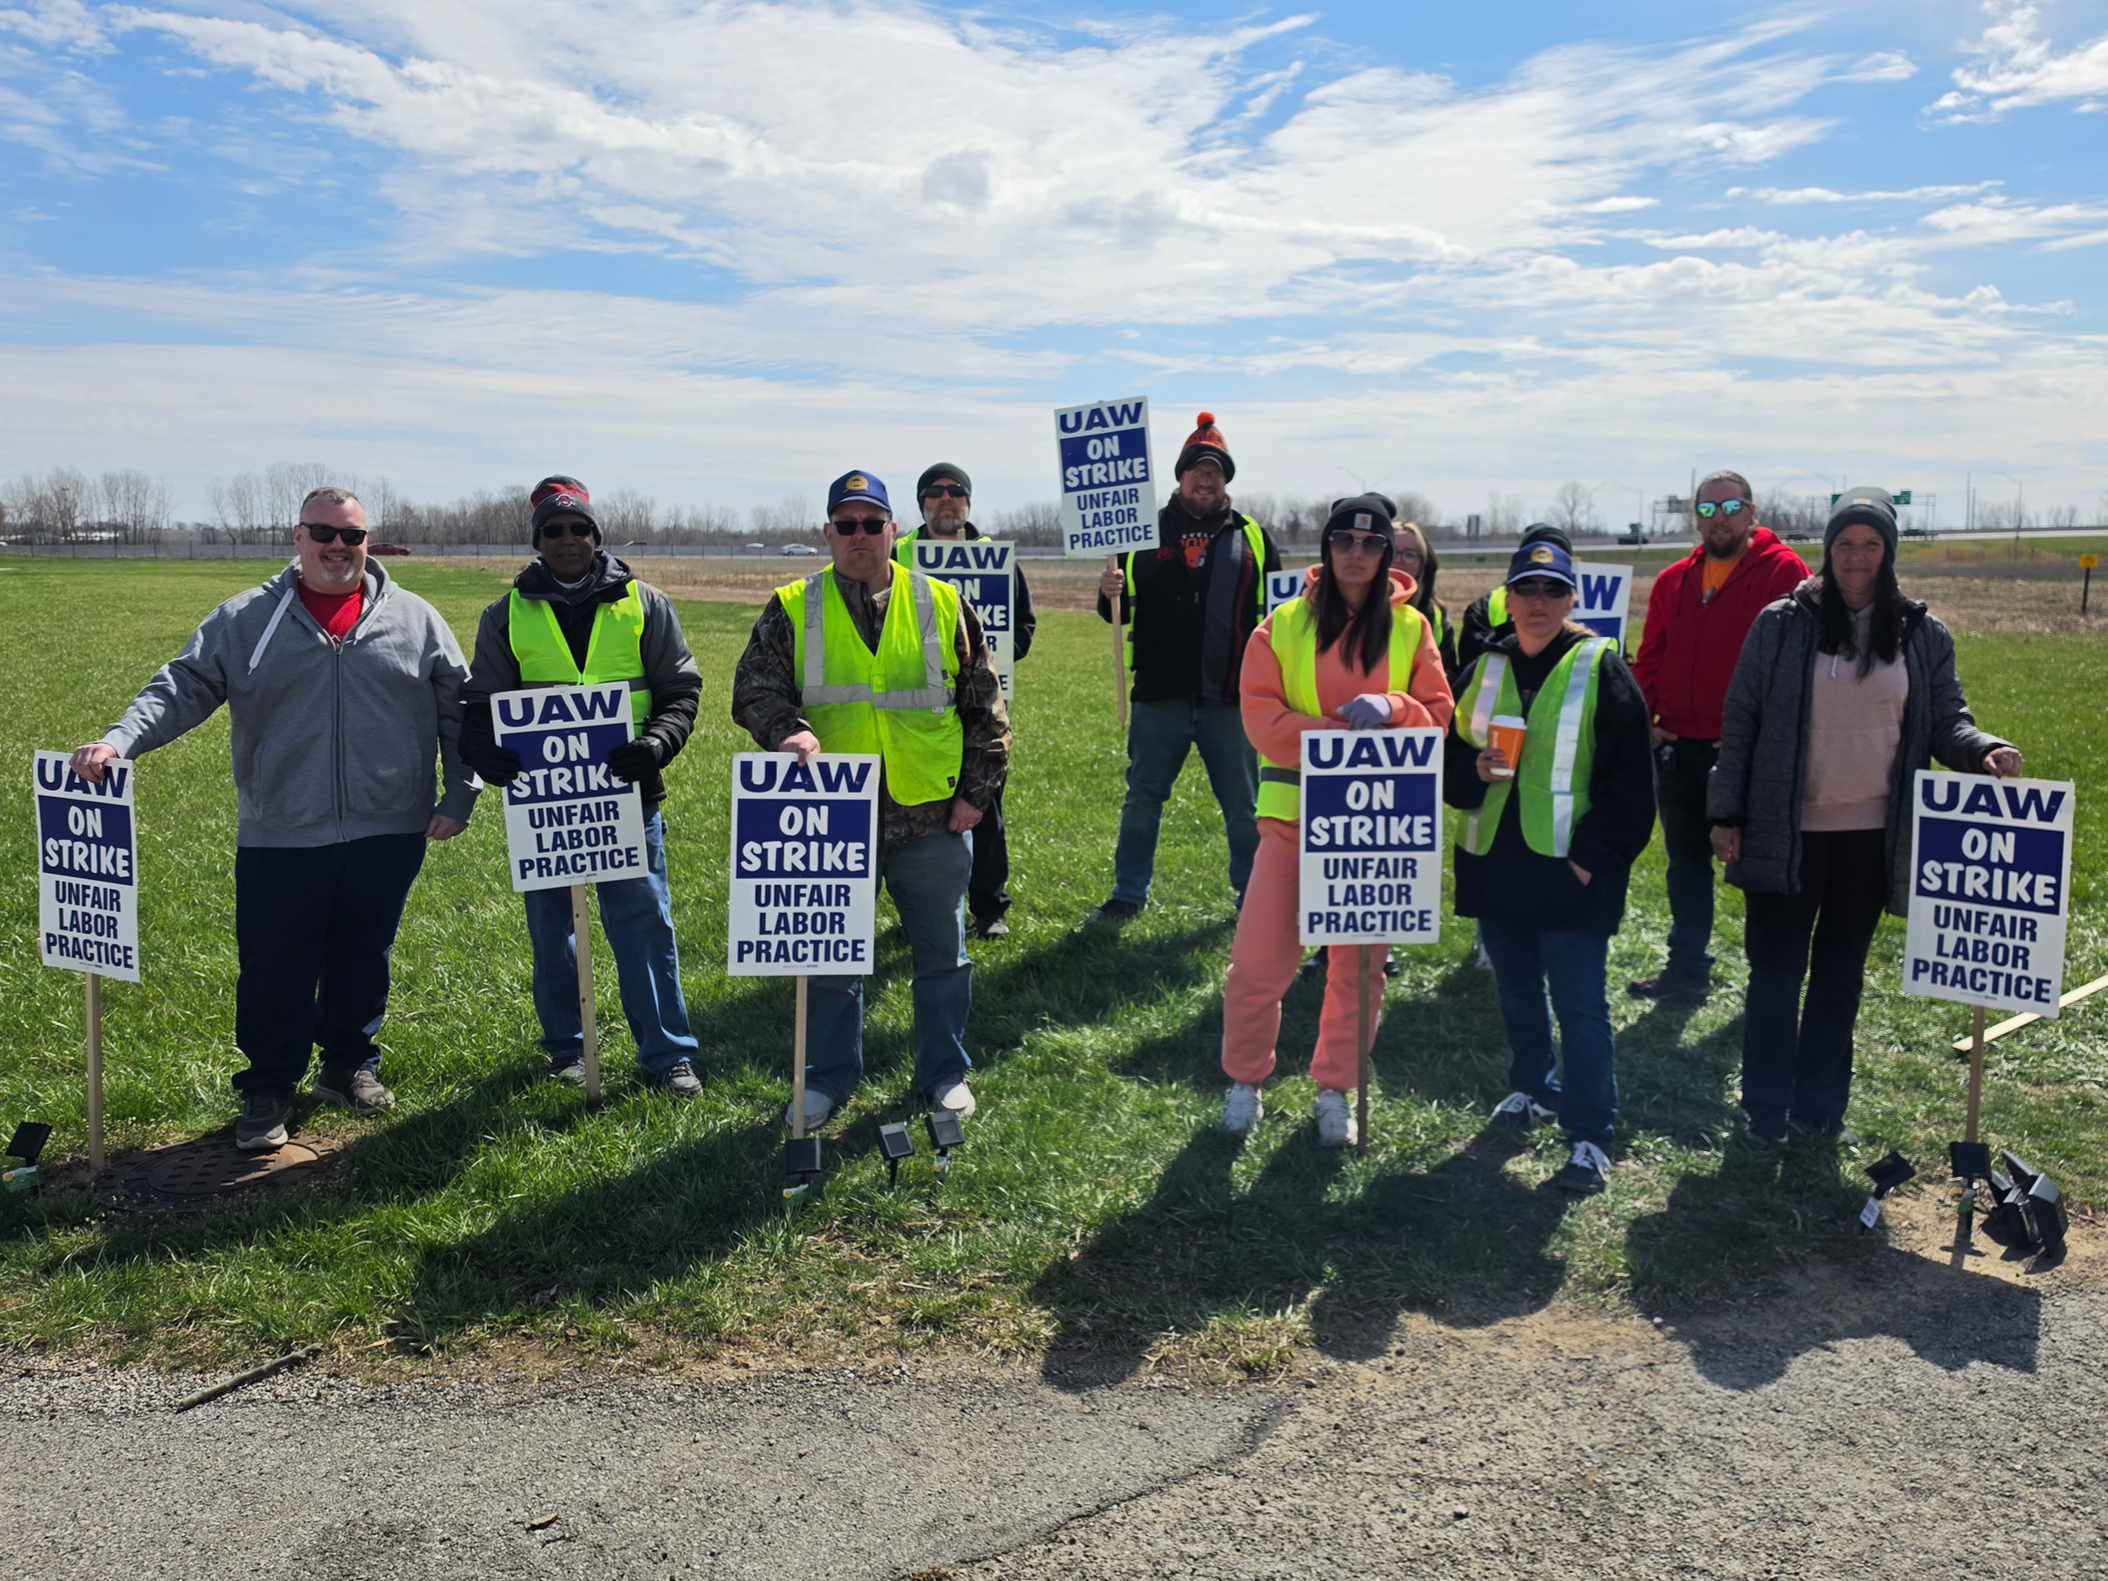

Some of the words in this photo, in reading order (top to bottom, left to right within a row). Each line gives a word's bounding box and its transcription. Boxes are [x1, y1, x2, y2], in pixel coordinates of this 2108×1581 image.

[1060, 402, 1143, 434] UAW
[1087, 435, 1120, 460] ON
[1065, 457, 1147, 488] STRIKE
[1077, 488, 1139, 511] UNFAIR
[1082, 507, 1138, 529] LABOR
[1070, 524, 1153, 550] PRACTICE
[917, 546, 1010, 570] UAW
[498, 689, 623, 728] UAW
[543, 732, 590, 763] ON
[1308, 736, 1437, 769] UAW
[38, 758, 128, 799] UAW
[740, 760, 872, 793] UAW
[1346, 779, 1394, 811] ON
[1922, 779, 2066, 823] UAW
[68, 805, 102, 838] ON
[528, 800, 619, 829] UNFAIR
[779, 805, 829, 836] ON
[1309, 814, 1432, 846] STRIKE
[535, 825, 618, 853] LABOR
[1961, 828, 2016, 864] ON
[45, 837, 130, 878] STRIKE
[518, 847, 639, 880] PRACTICE
[740, 840, 866, 872] STRIKE
[1324, 858, 1417, 880] UNFAIR
[55, 880, 121, 912] UNFAIR
[755, 884, 851, 908] UNFAIR
[1328, 884, 1412, 906] LABOR
[1920, 860, 2057, 907] STRIKE
[59, 907, 118, 940] LABOR
[759, 912, 845, 935] LABOR
[1308, 910, 1432, 933] PRACTICE
[1934, 904, 2038, 942] UNFAIR
[46, 932, 134, 970] PRACTICE
[737, 939, 865, 963] PRACTICE
[1936, 933, 2030, 971] LABOR
[1912, 958, 2052, 1004] PRACTICE
